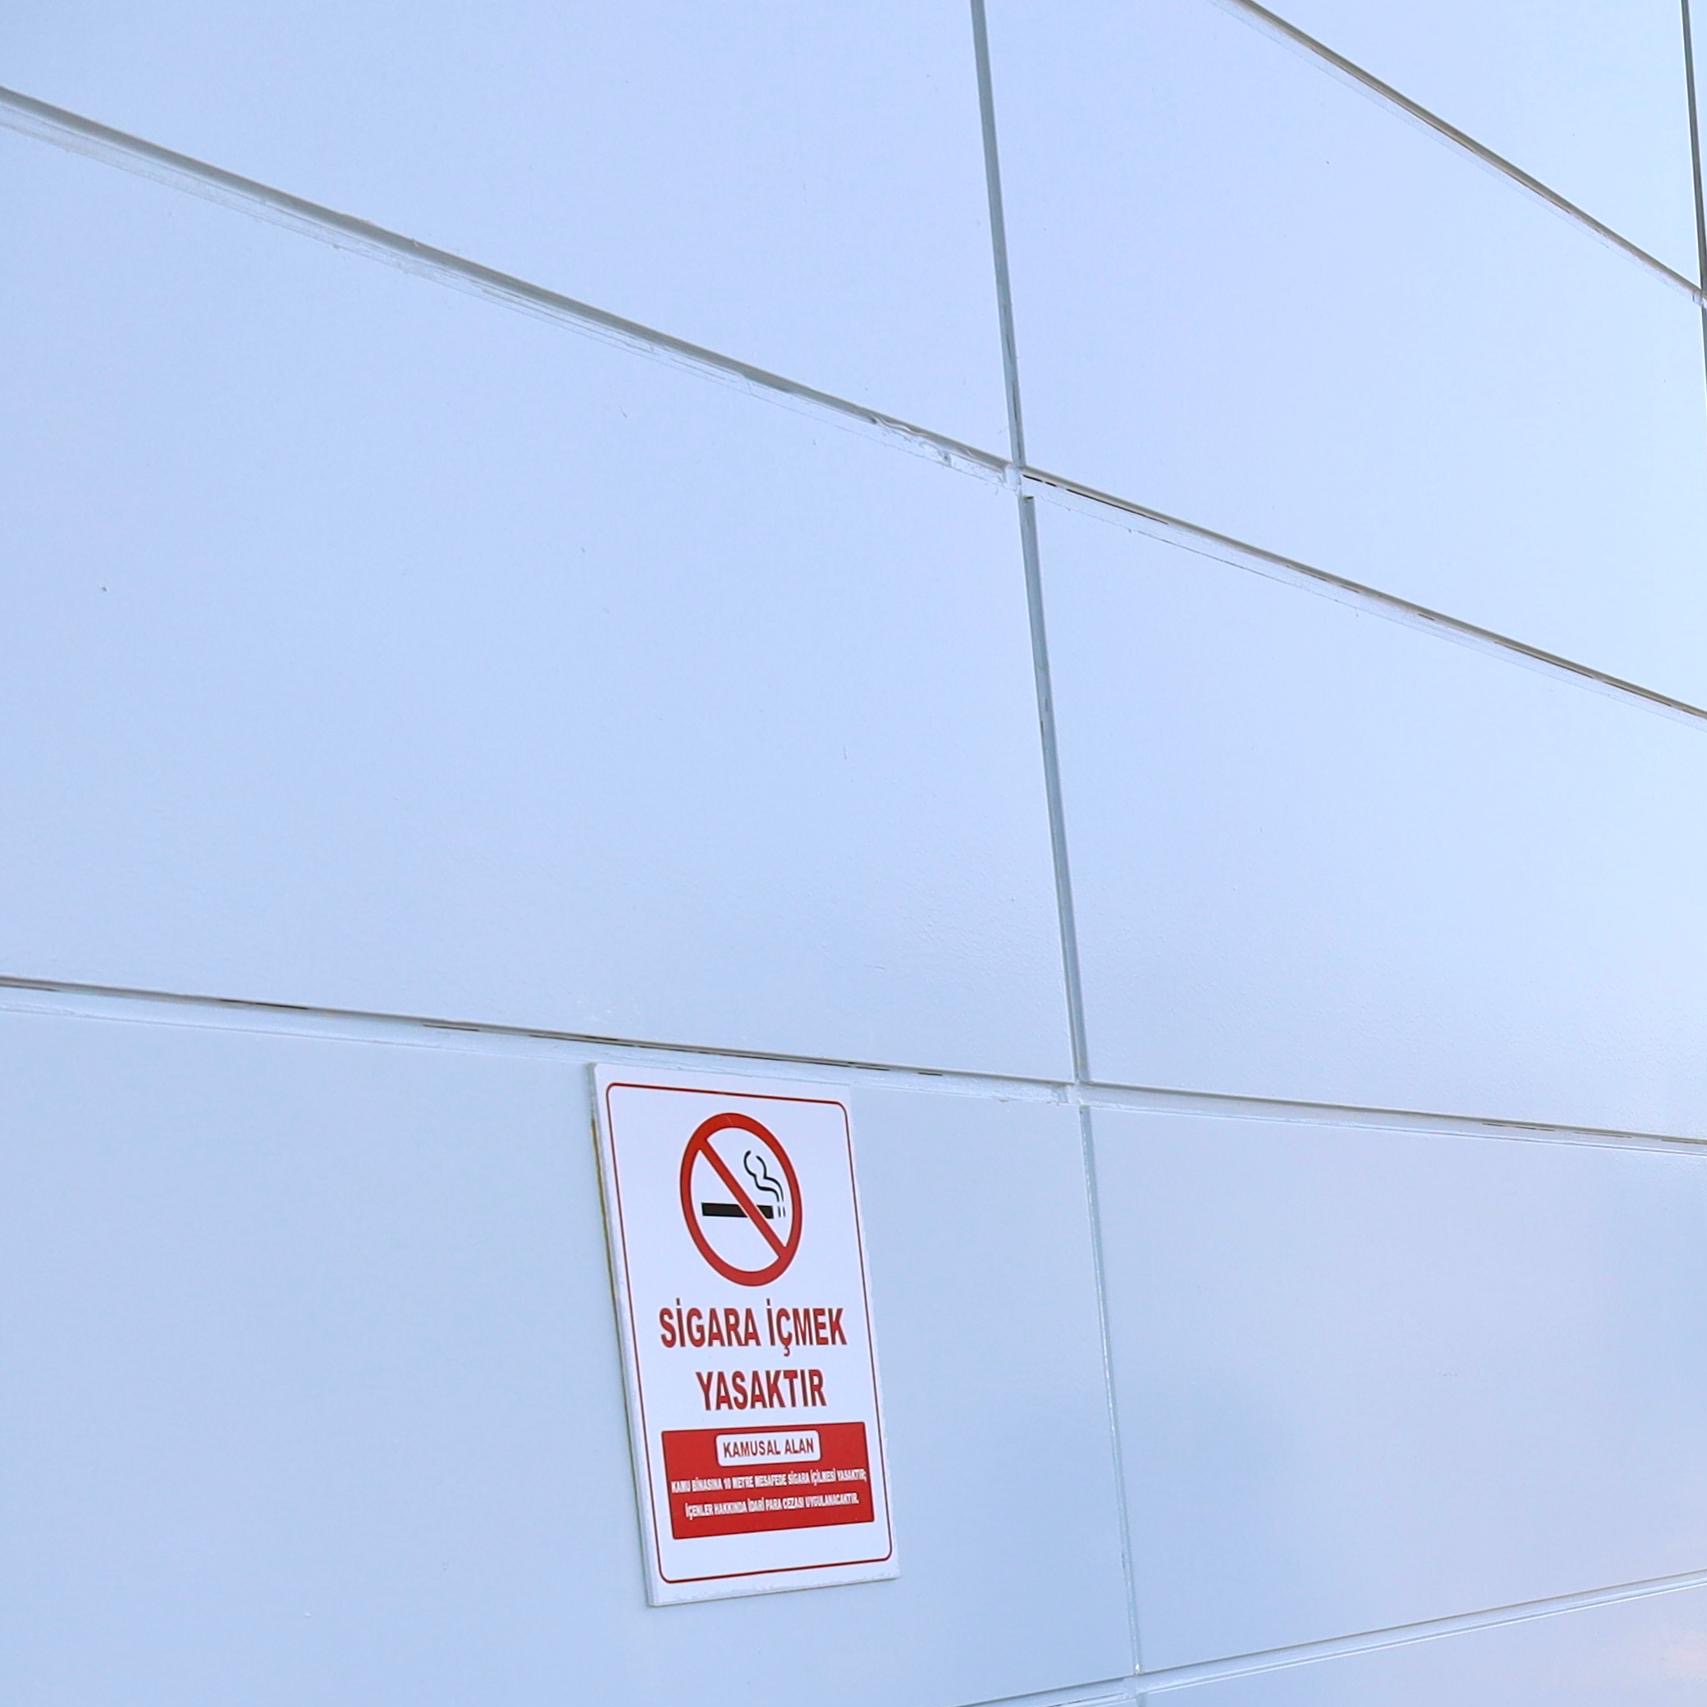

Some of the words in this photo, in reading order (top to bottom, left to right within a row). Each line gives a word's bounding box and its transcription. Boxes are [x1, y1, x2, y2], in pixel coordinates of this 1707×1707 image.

[659, 1297, 762, 1348] SİGARA
[766, 1297, 848, 1357] İÇMEK
[695, 1369, 828, 1411] YASAKTIR
[723, 1438, 781, 1458] KAMUSAL
[785, 1437, 815, 1454] ALAN
[788, 1469, 811, 1485] SİGARA
[765, 1498, 783, 1512] PARA
[782, 1496, 805, 1510] CEZASI
